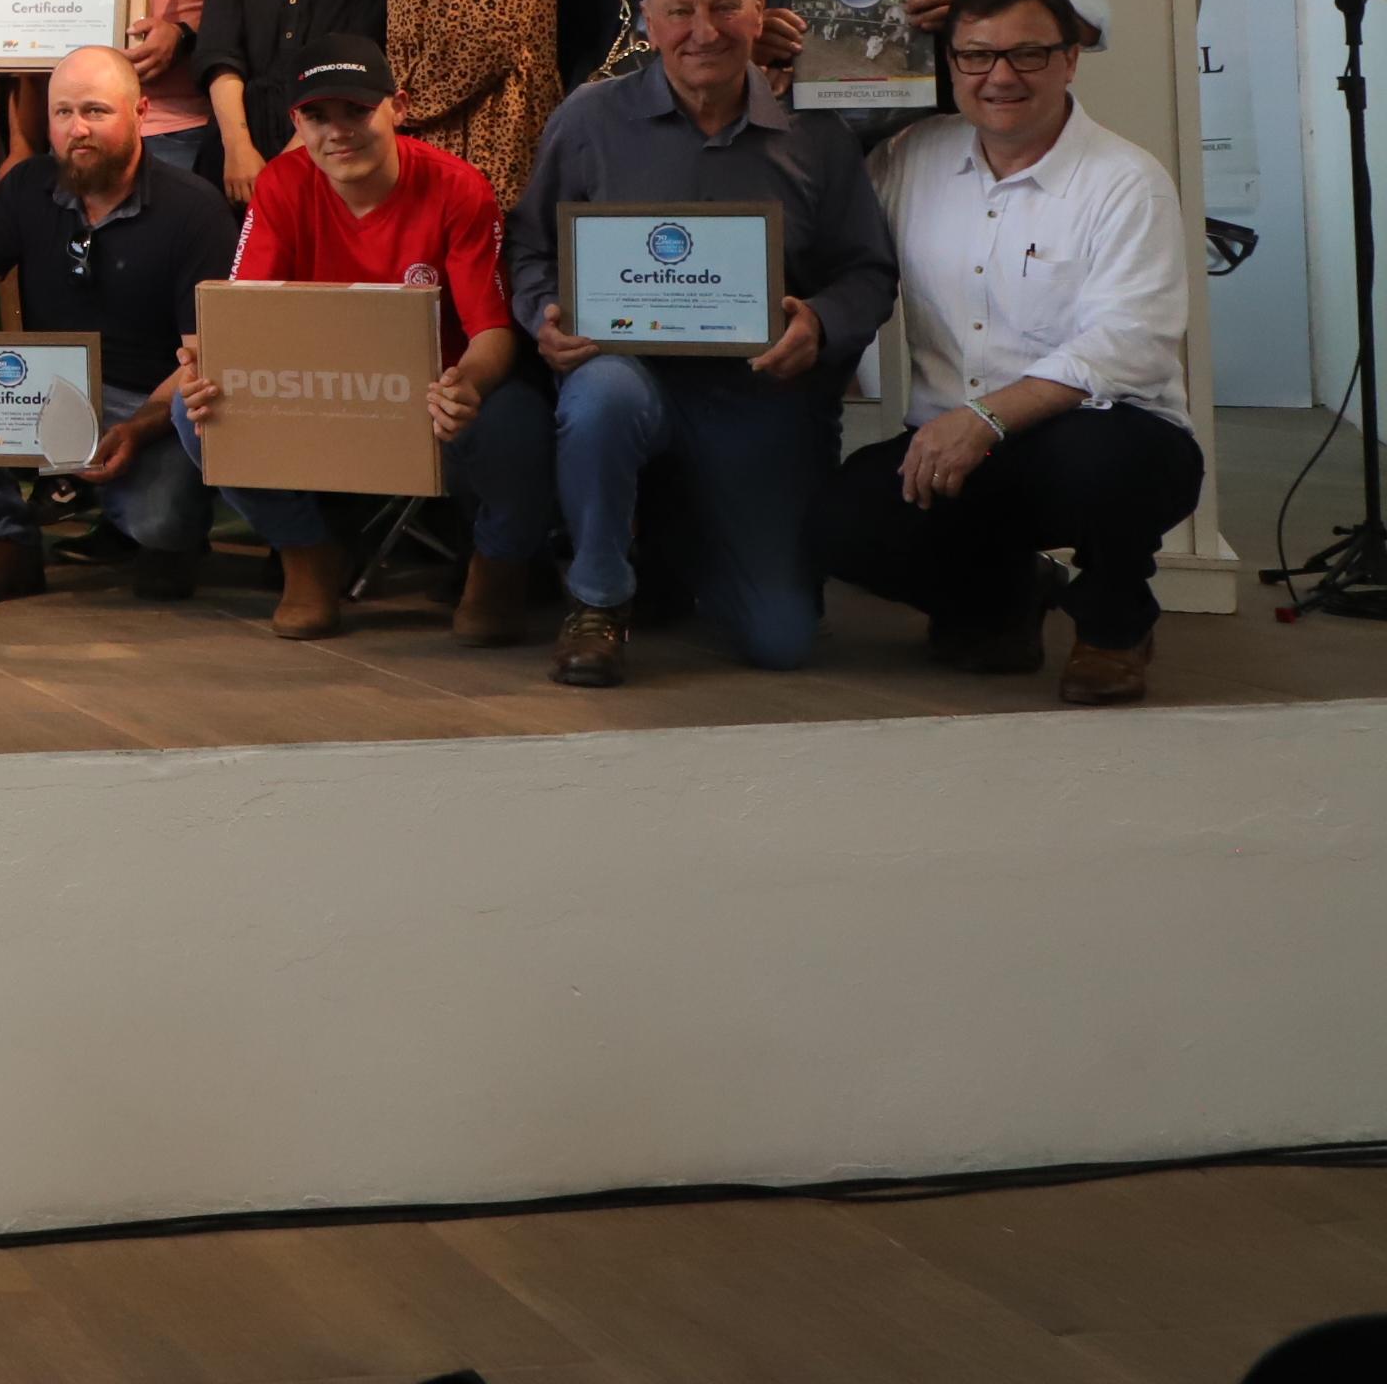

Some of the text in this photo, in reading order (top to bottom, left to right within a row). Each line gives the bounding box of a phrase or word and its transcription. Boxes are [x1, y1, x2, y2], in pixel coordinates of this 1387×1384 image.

[12, 1, 83, 14] Certificado
[336, 63, 367, 72] CHEMICAL
[229, 208, 254, 281] RAMONTINA
[620, 269, 722, 285] Certificado
[222, 368, 412, 403] POSITIVO
